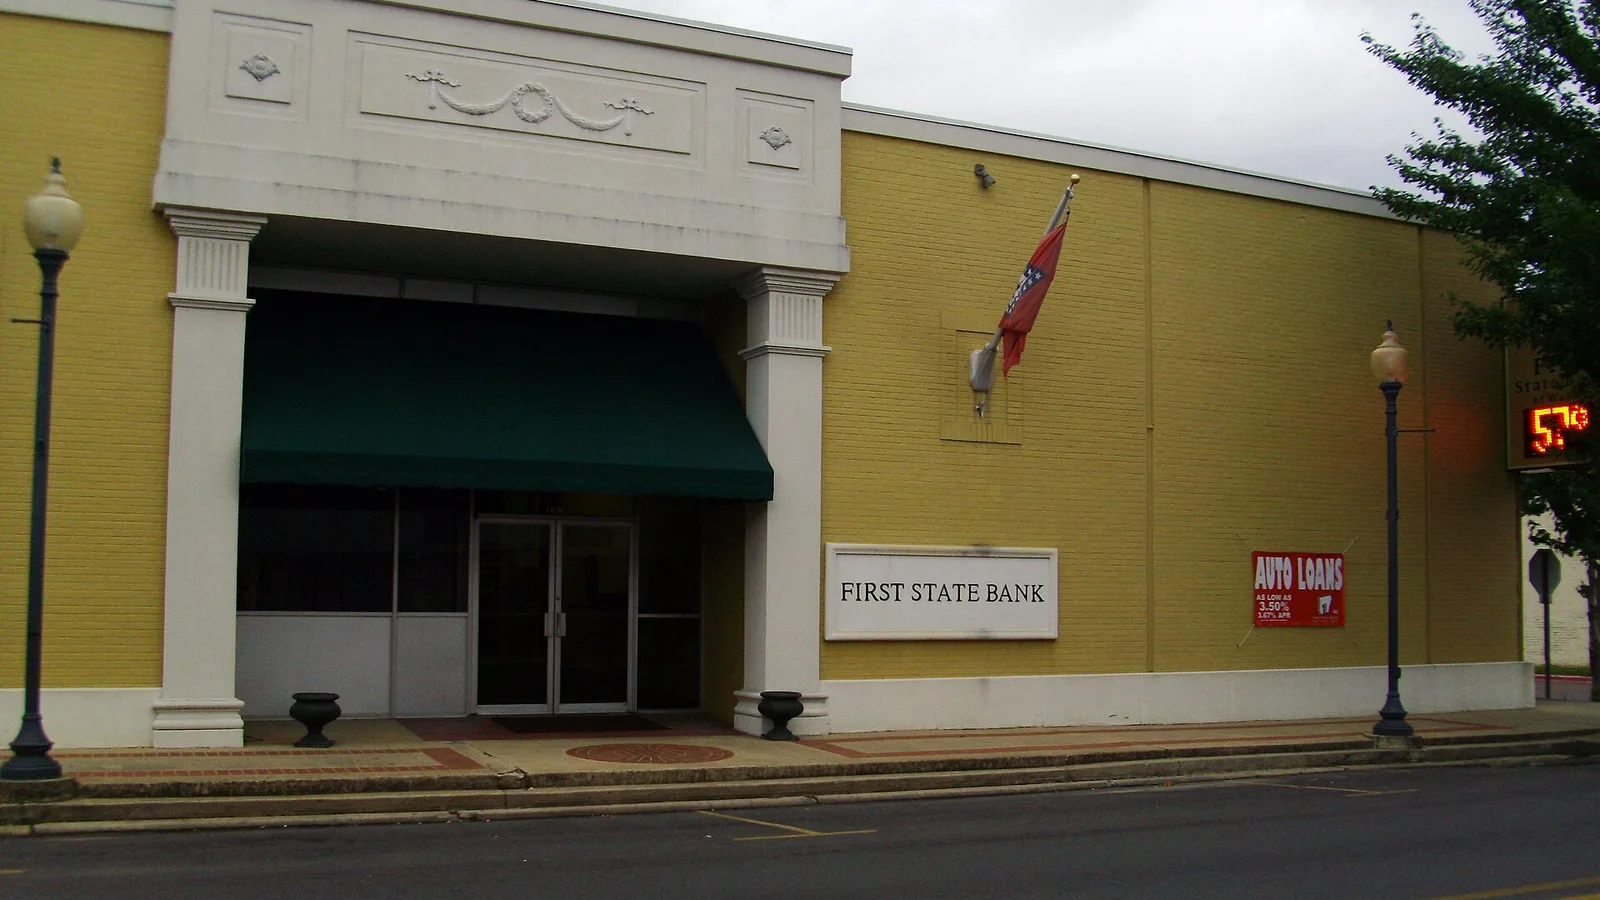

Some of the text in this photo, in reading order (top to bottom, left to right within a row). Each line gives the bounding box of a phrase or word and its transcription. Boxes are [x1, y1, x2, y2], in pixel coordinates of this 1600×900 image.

[1254, 556, 1343, 591] AUTO LOANS
[840, 582, 1045, 603] FIRST STATE BANK
[1259, 601, 1290, 611] 3.50%
